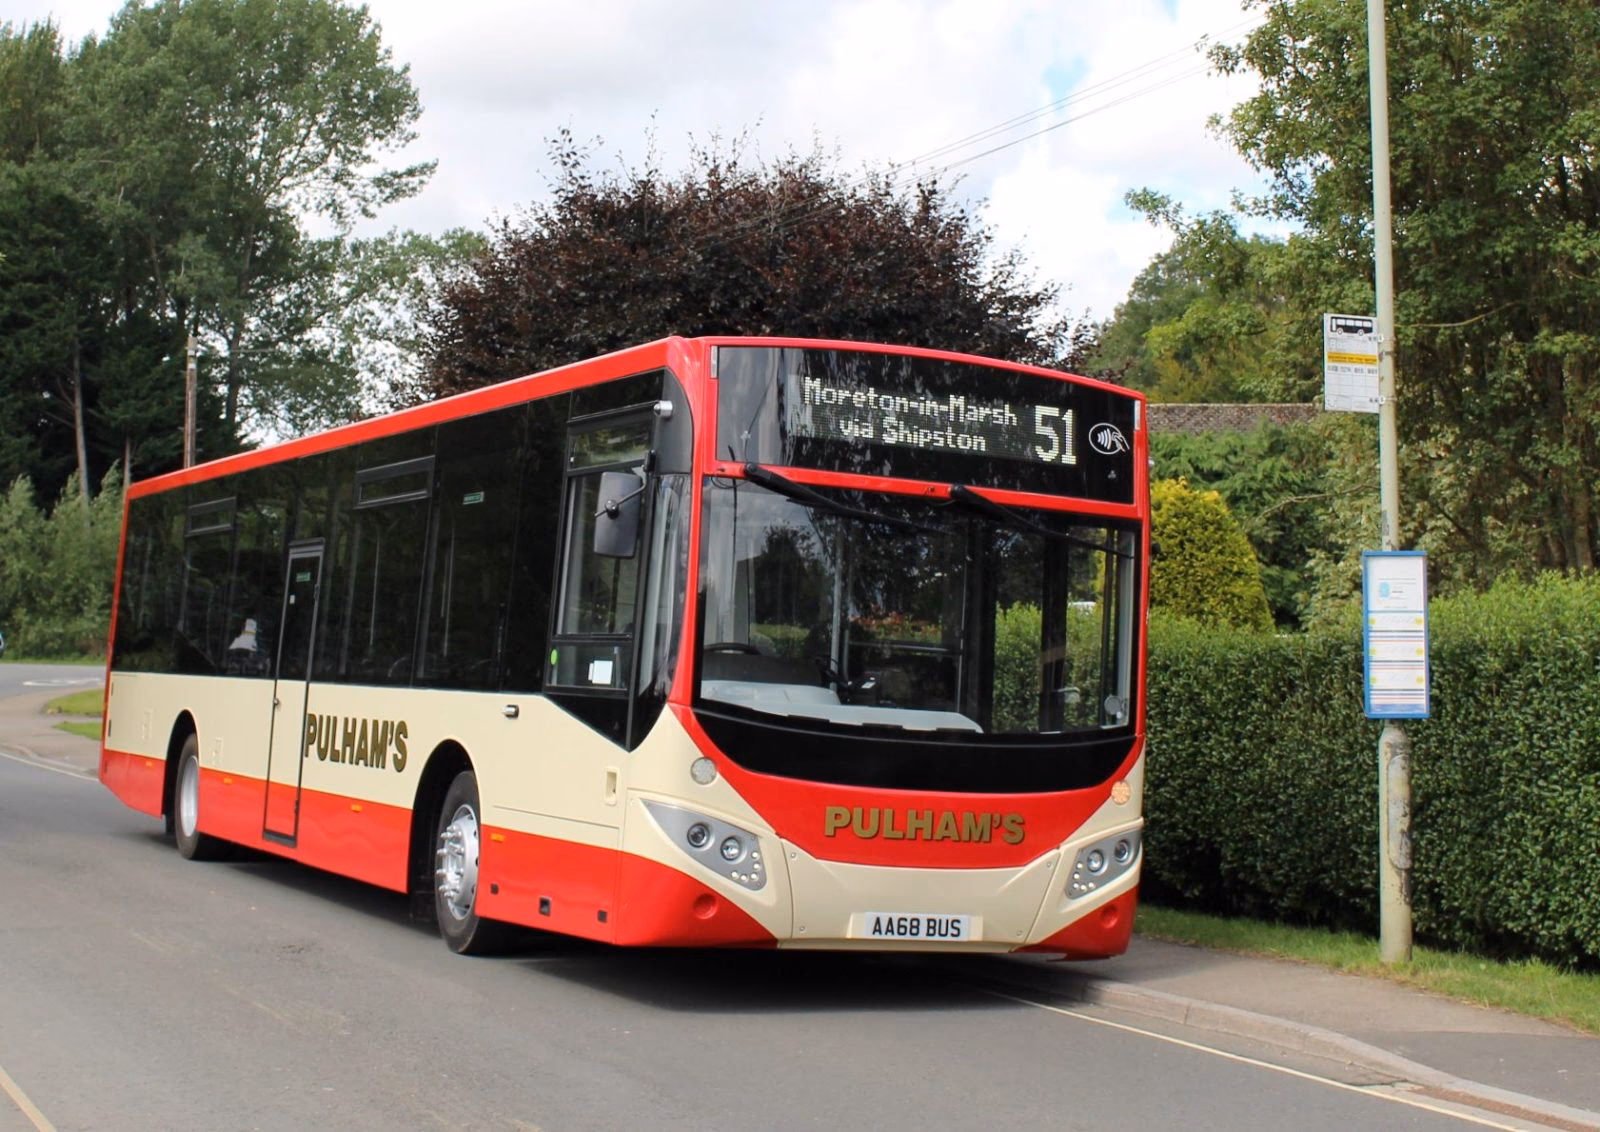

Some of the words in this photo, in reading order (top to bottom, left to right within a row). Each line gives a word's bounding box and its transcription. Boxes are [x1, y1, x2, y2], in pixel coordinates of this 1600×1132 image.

[804, 376, 1018, 427] Moreton-in-Marsh
[839, 418, 874, 439] via
[882, 415, 986, 452] Shipston
[1035, 404, 1078, 466] 51
[304, 713, 409, 773] PULHAM'S
[824, 805, 1026, 845] PULHAM'S
[872, 916, 921, 937] AA68
[925, 917, 962, 938] BUS
